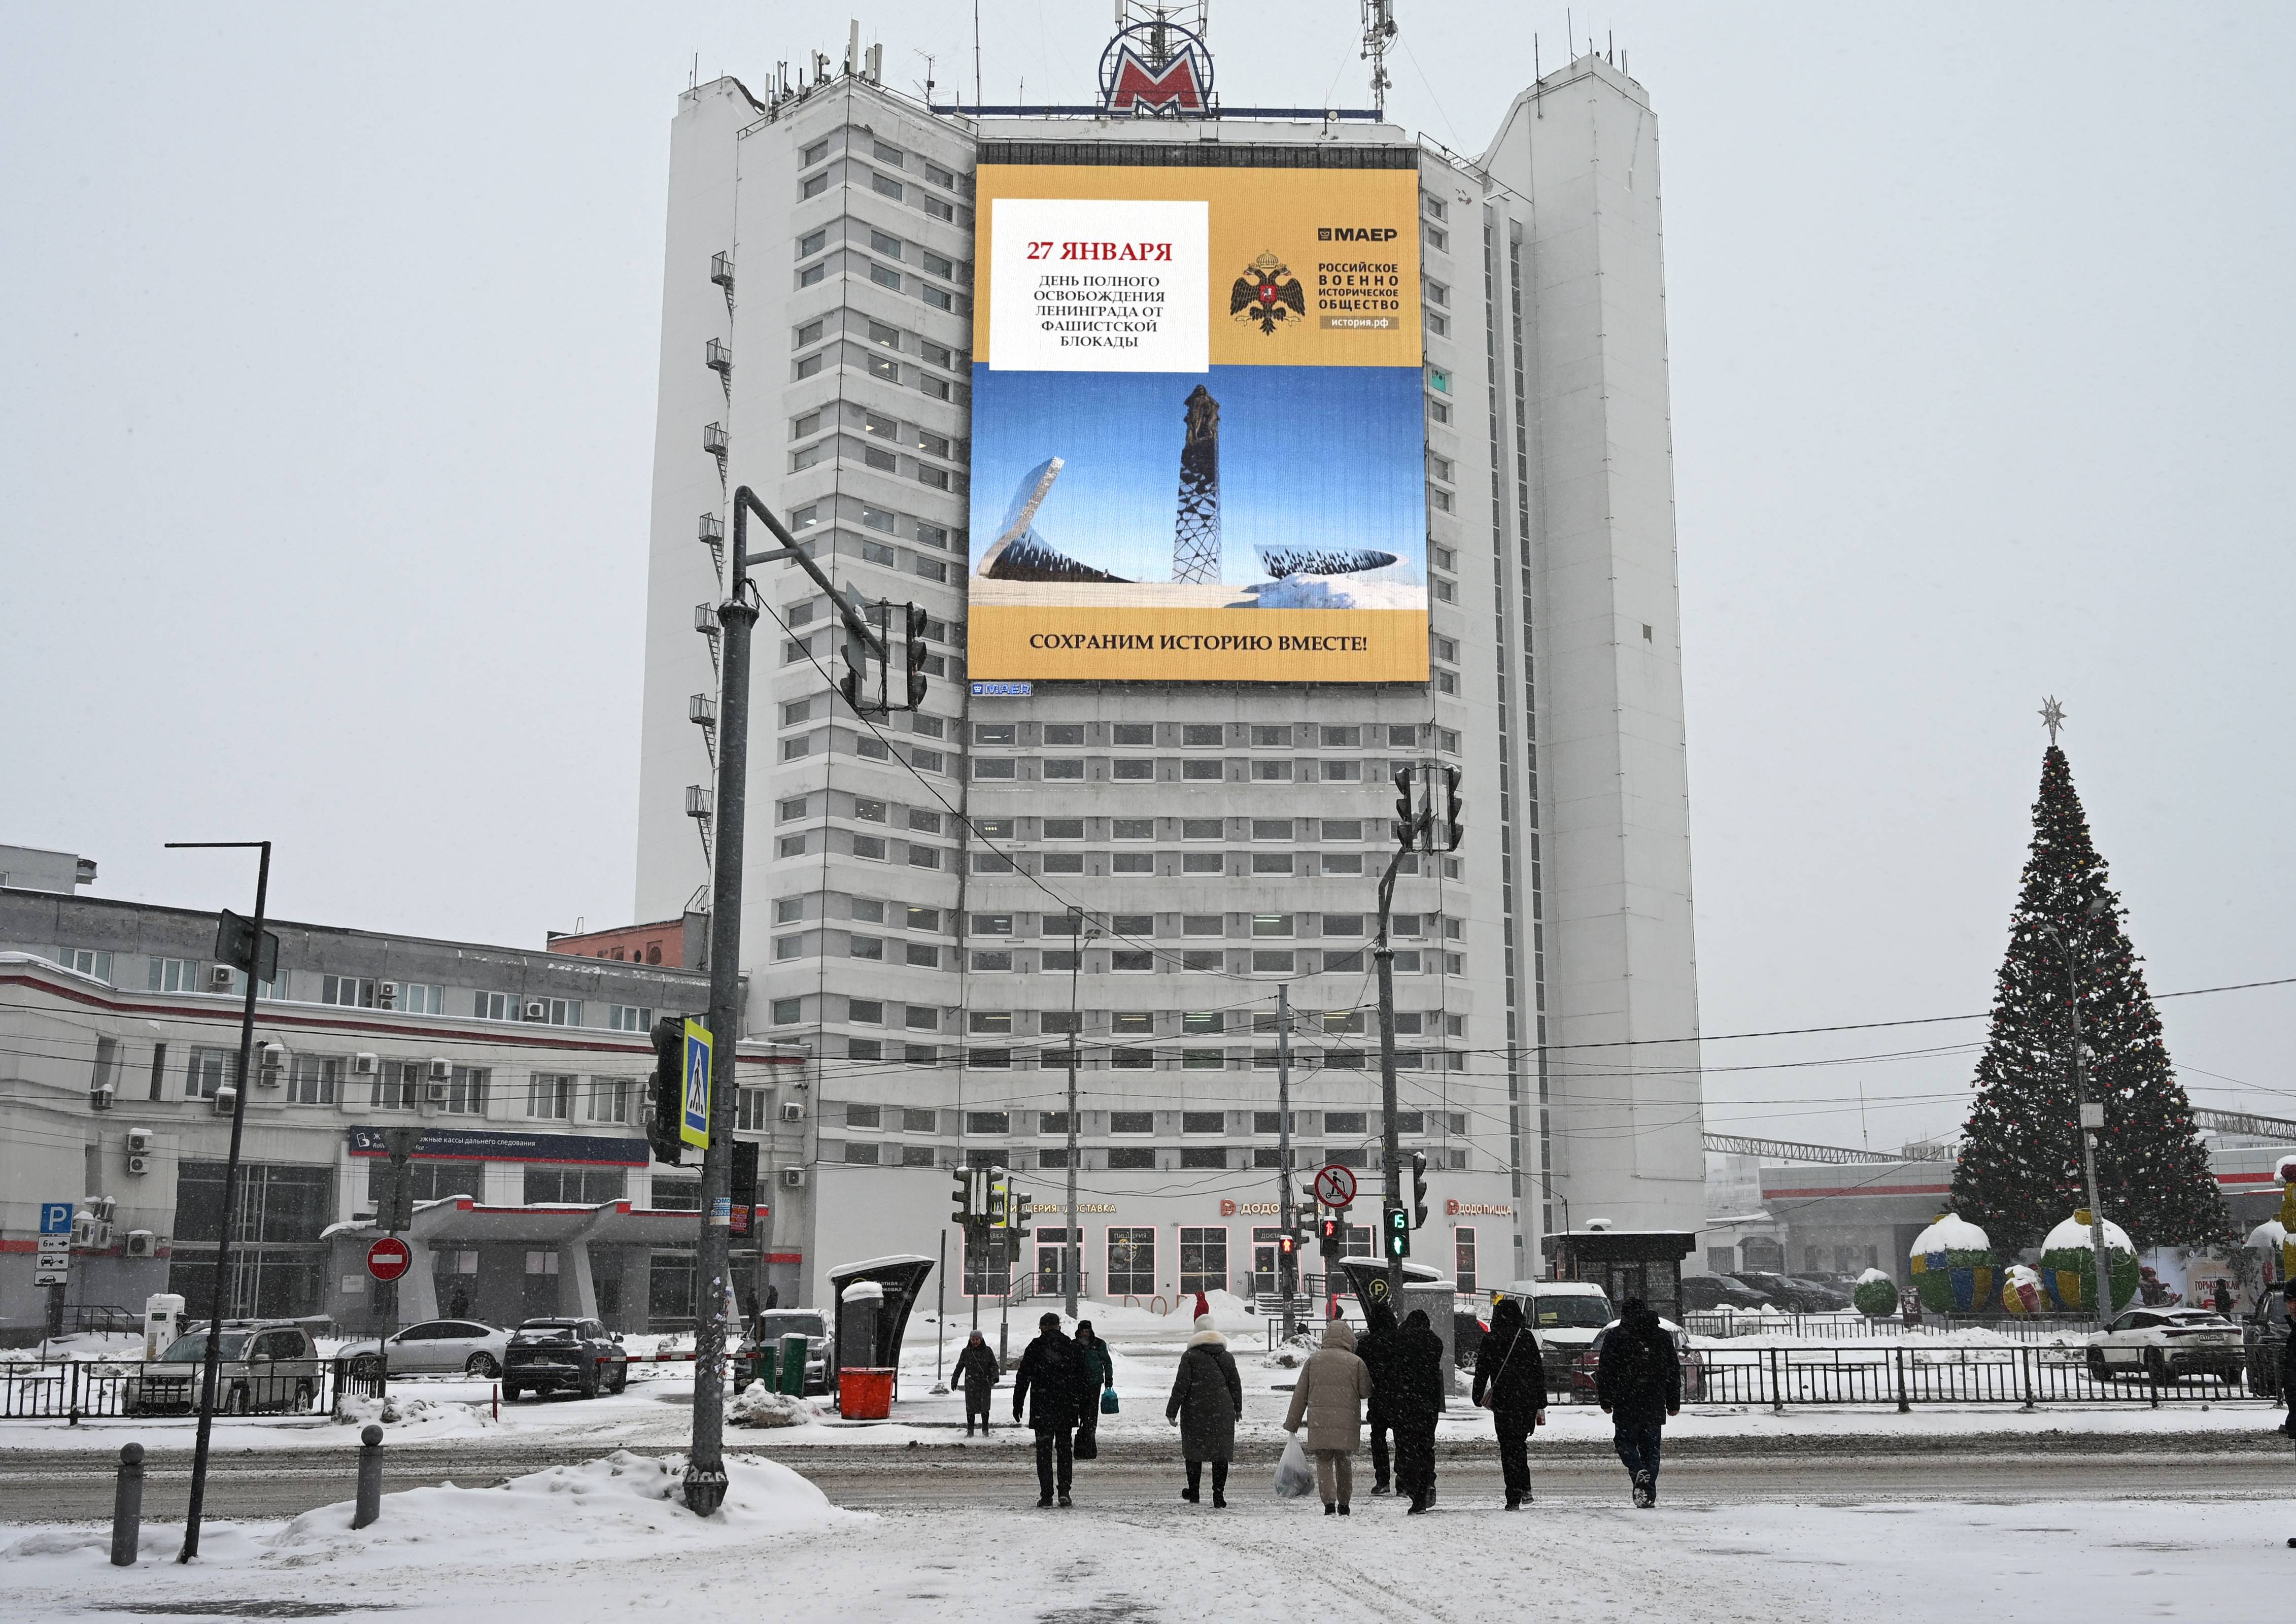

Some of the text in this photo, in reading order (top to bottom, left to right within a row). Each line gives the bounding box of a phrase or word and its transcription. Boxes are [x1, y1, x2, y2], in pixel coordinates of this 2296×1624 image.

[1334, 228, 1397, 242] МАЕР
[1027, 242, 1173, 261] 27 ЯНВАРЯ
[1318, 261, 1398, 273] РОССИЙСКОЕ
[1039, 275, 1160, 288] ДЕНЬ ПОЛНОГО
[1319, 275, 1399, 286] ВОЕННО
[1034, 290, 1165, 303] ОСВОБОЖДЕНИЯ
[1318, 288, 1399, 297] ИСТОРИЧЕСКОЕ
[1319, 299, 1399, 312] ОБЩЕСТВО
[1035, 306, 1163, 319] ЛЕНИНГРАДА ОТ
[1041, 319, 1157, 332] ФАШИСТСКОЙ
[1331, 318, 1389, 328] история.рф
[1060, 336, 1138, 349] БЛОКАДЫ
[1029, 633, 1368, 652] СОХРАНИМ ИСТОРИЮ ВМЕСТЕ!
[985, 684, 1031, 694] MAER
[1241, 1203, 1280, 1215] ДОДО
[1460, 1203, 1512, 1217] ДОДО ПИЦЦА
[49, 1206, 67, 1231] P
[1394, 1214, 1404, 1228] 15
[2195, 1280, 2241, 1291] ГОРЬКОКАЯ
